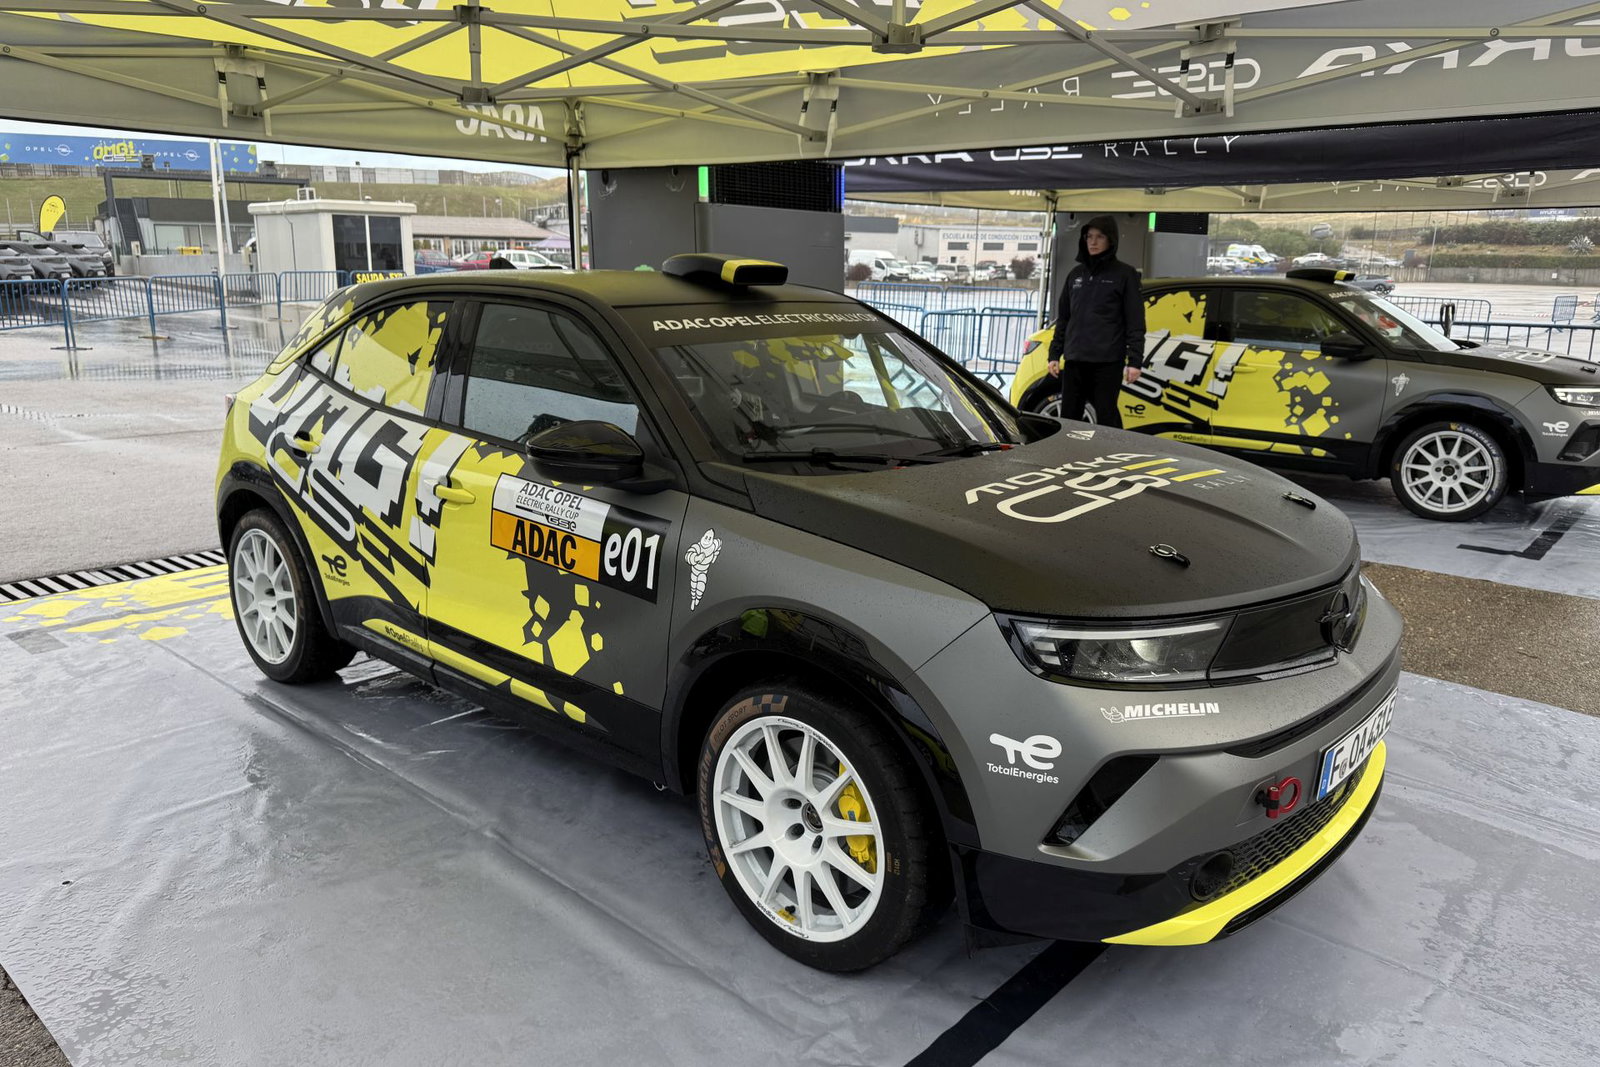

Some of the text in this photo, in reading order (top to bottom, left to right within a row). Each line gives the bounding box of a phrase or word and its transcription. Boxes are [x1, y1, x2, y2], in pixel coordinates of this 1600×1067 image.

[93, 140, 135, 160] OMG!
[652, 317, 711, 331] ADAC
[708, 315, 762, 328] OPEL
[754, 313, 828, 325] ELECTRIC
[964, 452, 1157, 505] MOKKA
[516, 495, 545, 510] ELECTRIC
[544, 504, 566, 517] RALLY
[565, 509, 580, 520] CUP
[520, 482, 583, 511] ADAC OPEL
[512, 519, 661, 590] ADAC e01
[727, 705, 748, 723] SPORT
[1124, 702, 1220, 719] MICHELIN
[986, 762, 1059, 784] TotalEnergies
